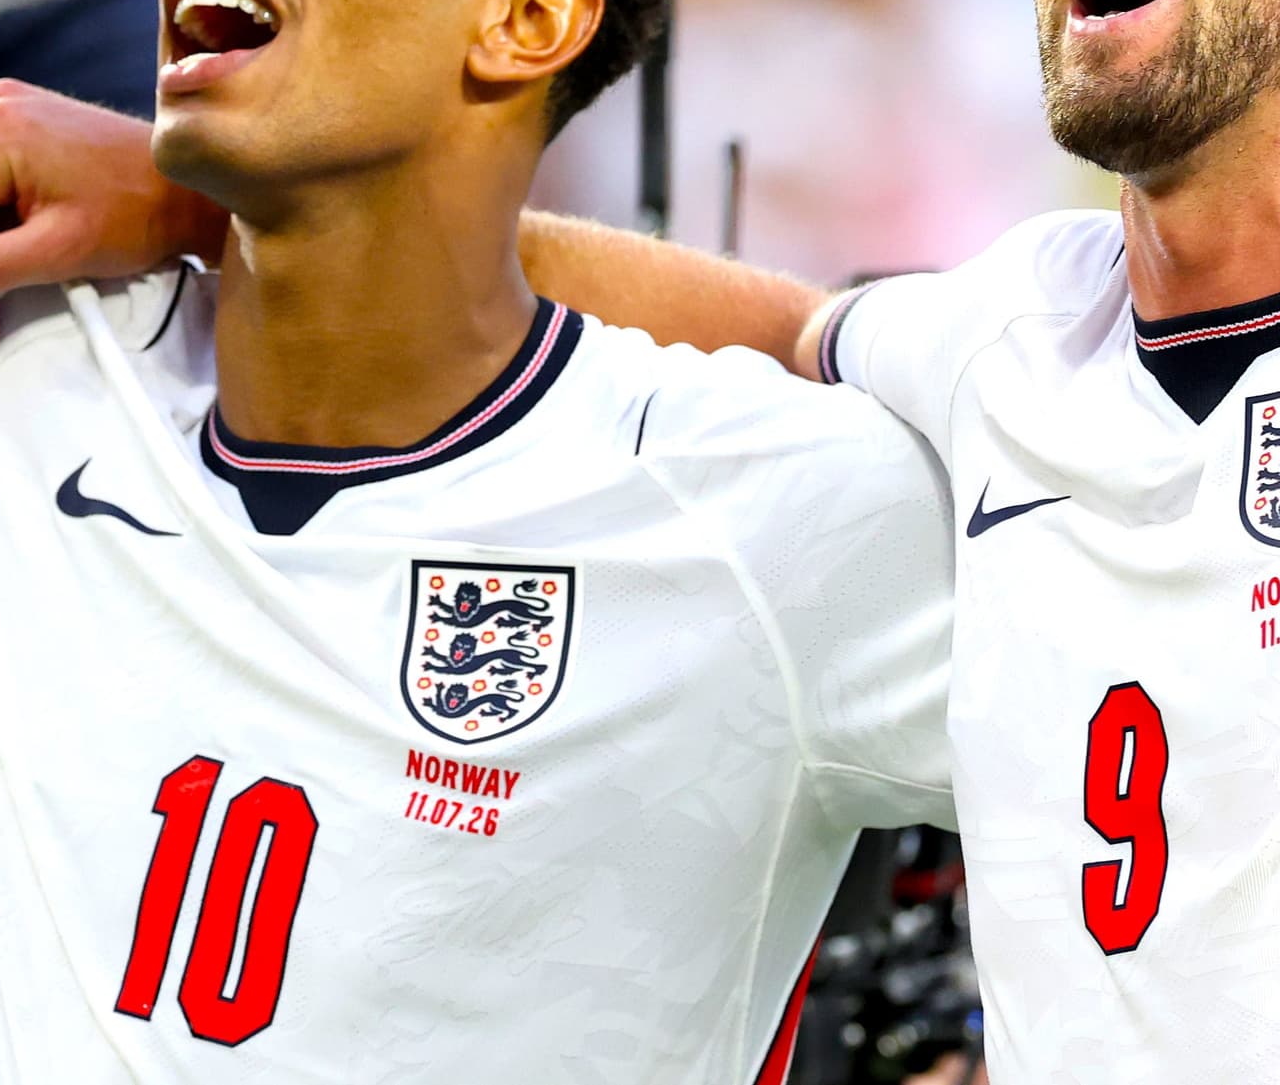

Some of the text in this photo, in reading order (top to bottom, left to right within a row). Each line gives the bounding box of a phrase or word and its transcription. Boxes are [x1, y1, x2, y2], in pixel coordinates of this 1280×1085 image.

[404, 790, 501, 837] 11.07.26
[405, 748, 521, 800] NORWAY
[1082, 681, 1168, 956] 9
[114, 755, 319, 1047] 10
